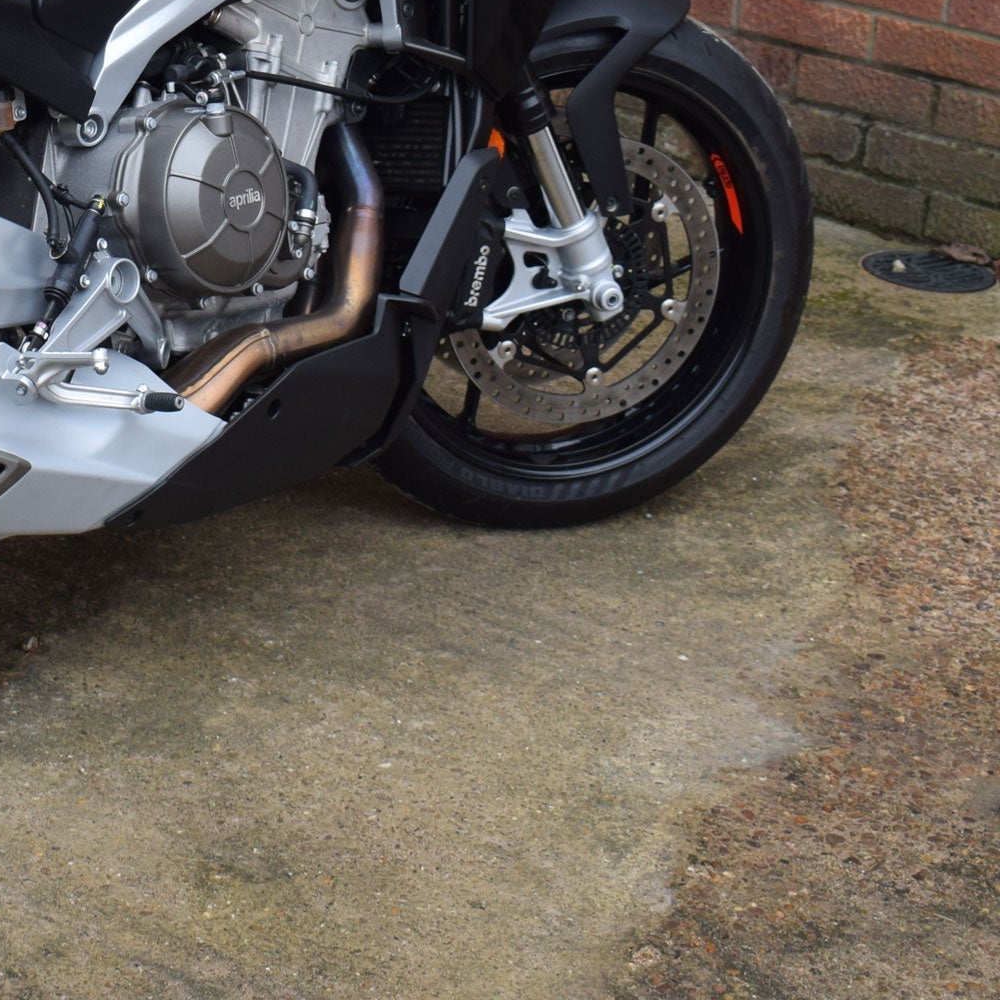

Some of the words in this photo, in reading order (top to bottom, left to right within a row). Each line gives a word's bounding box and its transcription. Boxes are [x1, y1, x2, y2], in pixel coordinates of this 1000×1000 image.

[230, 188, 261, 210] aprilia
[464, 245, 490, 307] brembo
[460, 467, 545, 498] DIABLO
